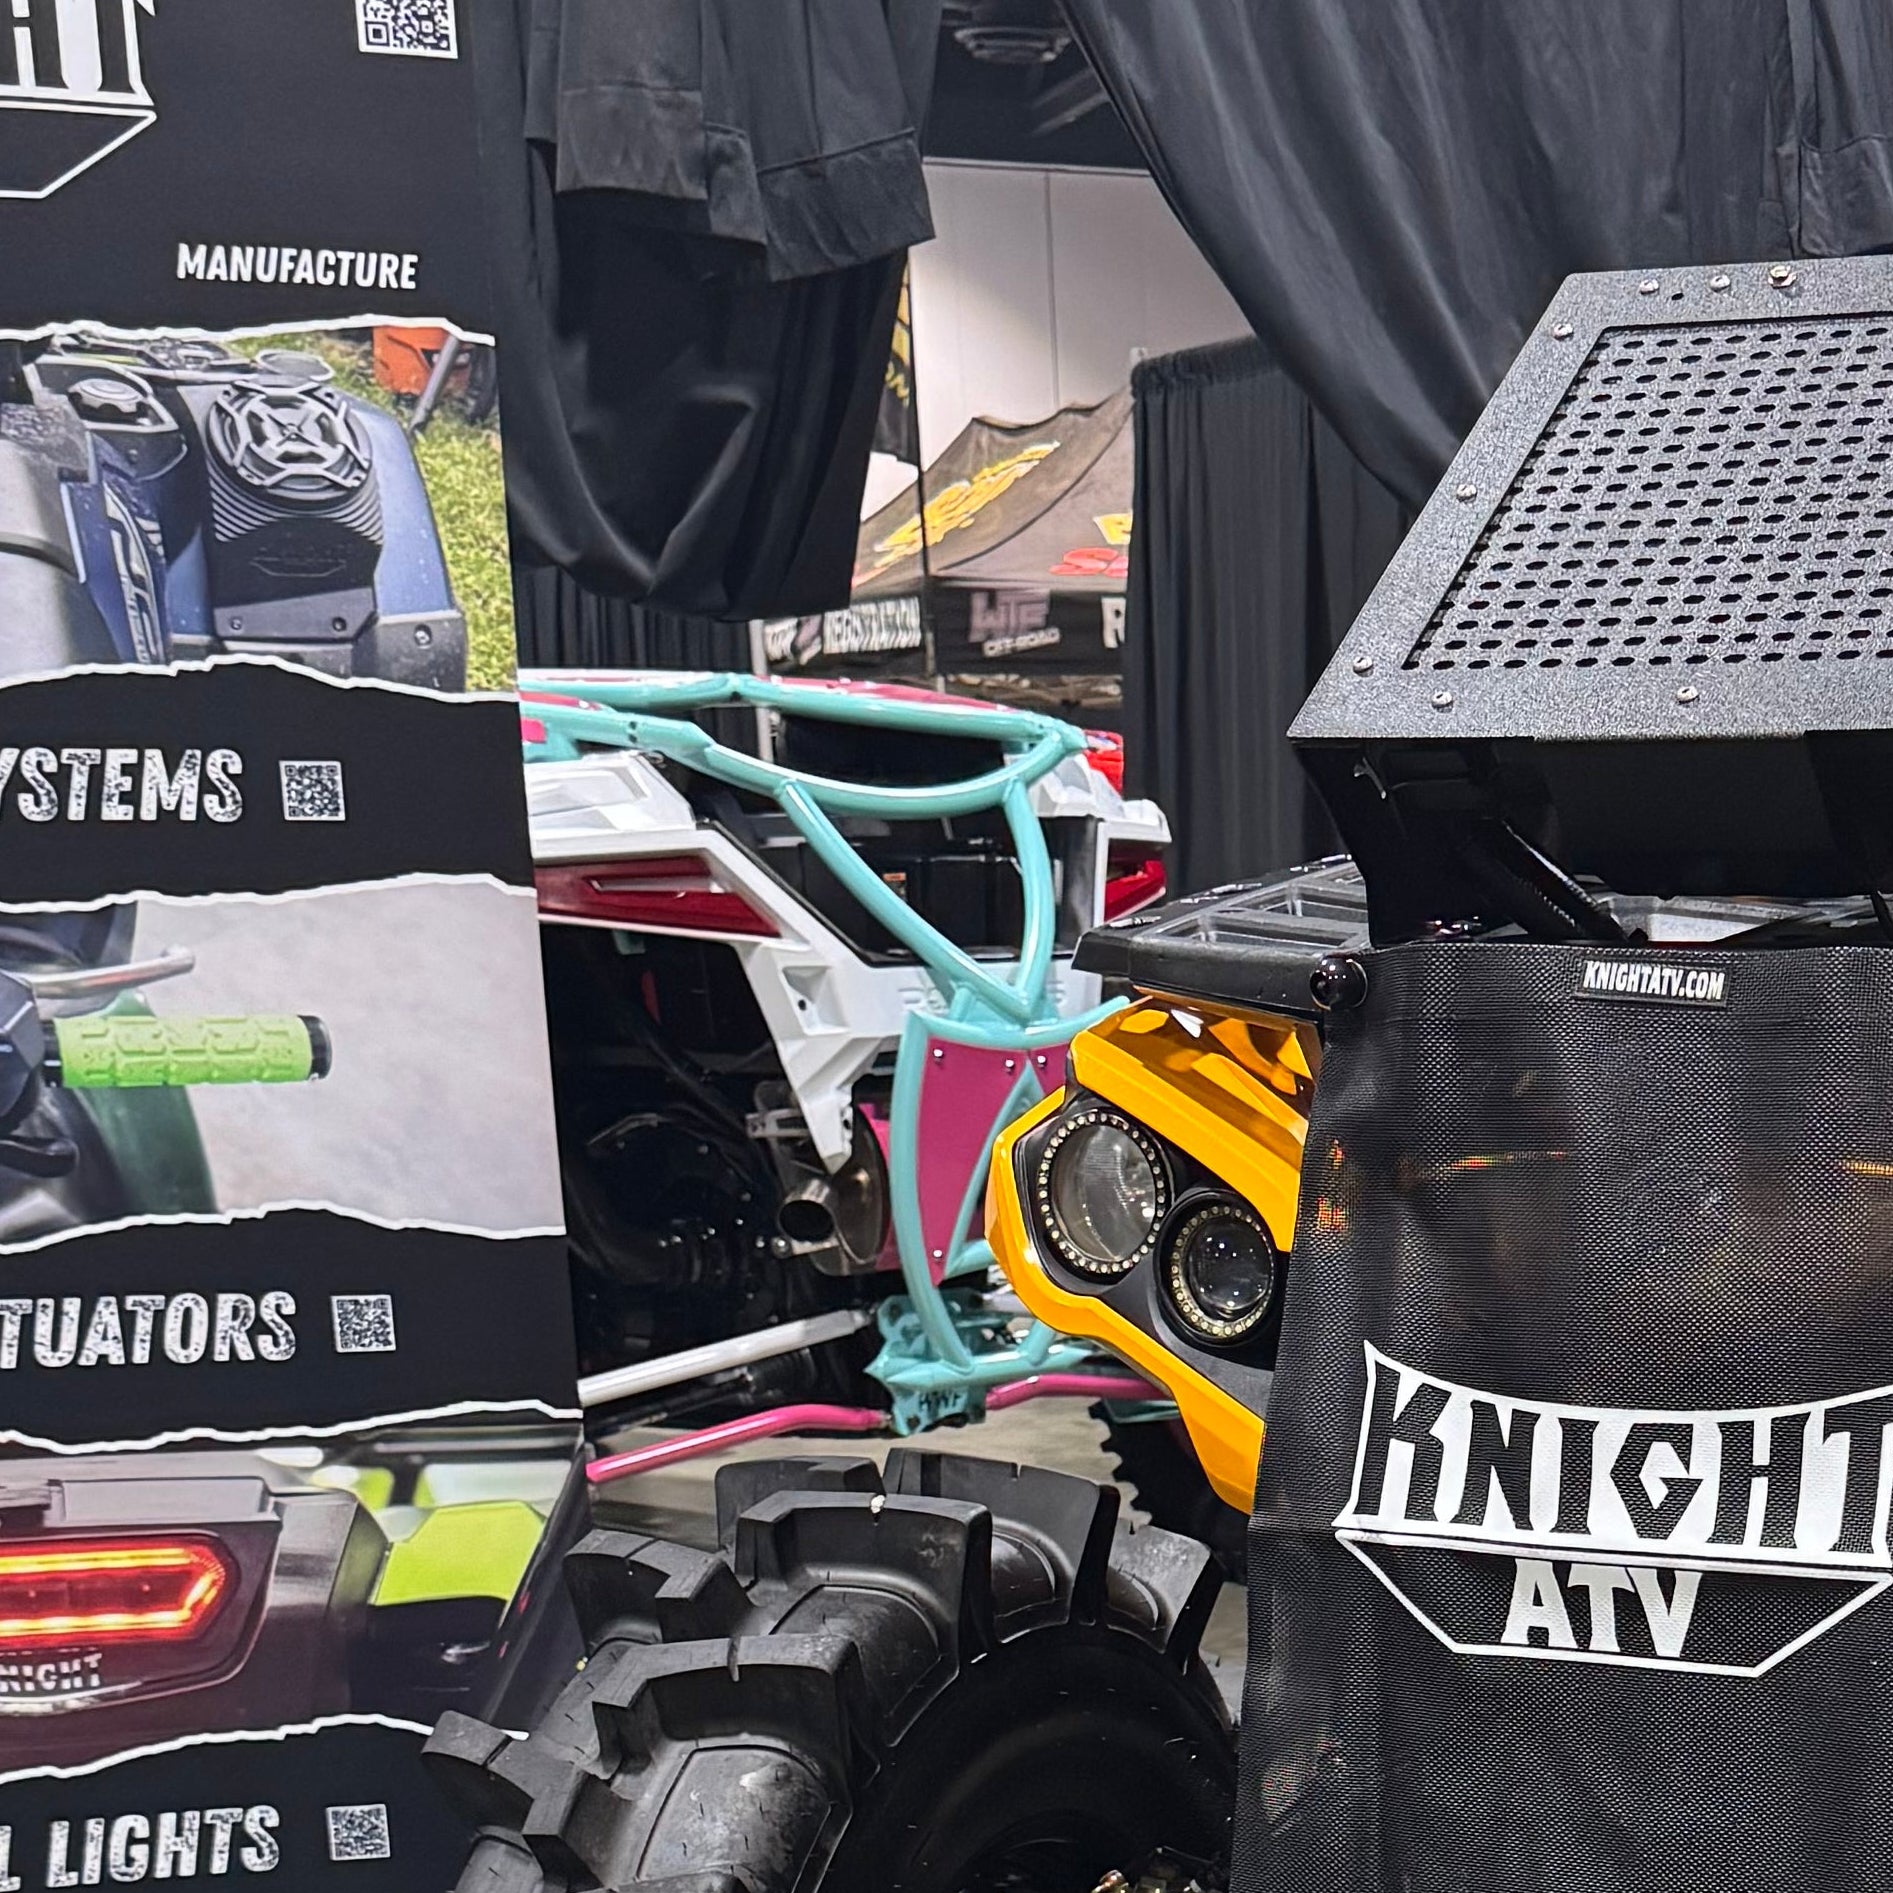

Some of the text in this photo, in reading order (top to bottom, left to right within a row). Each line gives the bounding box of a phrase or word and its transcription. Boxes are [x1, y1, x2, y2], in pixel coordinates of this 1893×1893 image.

[176, 242, 419, 290] MANUFACTURE
[1582, 960, 1726, 1000] KNIGHTATV.COM
[0, 1290, 297, 1369] TUATORS
[1500, 1558, 1704, 1658] ATV
[46, 1804, 280, 1888] LIGHTS
